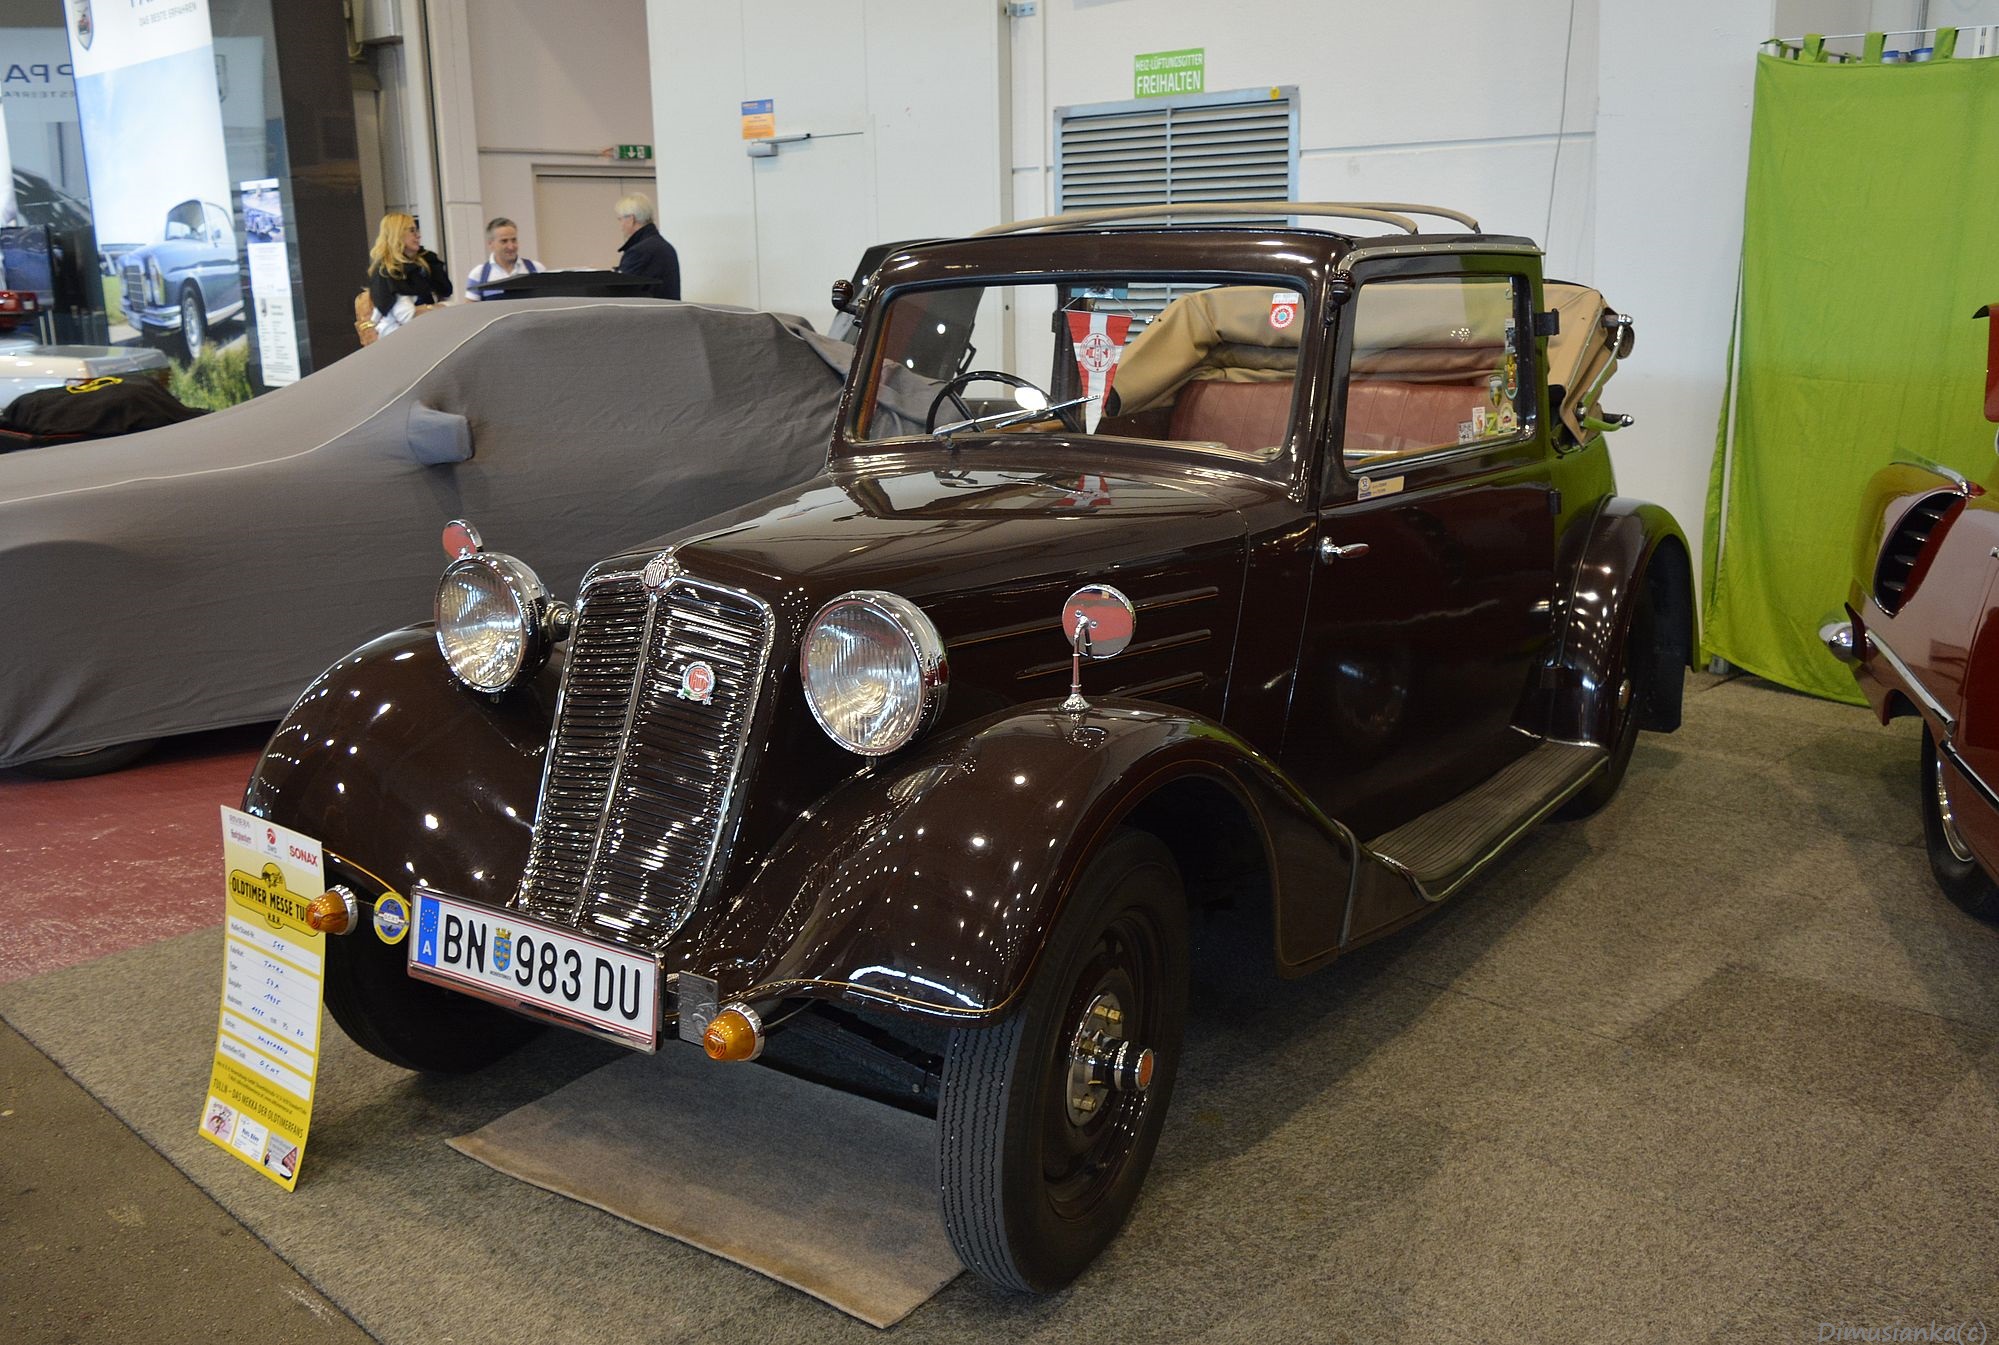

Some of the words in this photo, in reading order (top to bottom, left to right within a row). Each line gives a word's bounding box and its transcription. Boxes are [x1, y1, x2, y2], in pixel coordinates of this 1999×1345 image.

[1136, 70, 1201, 95] FREIHALTEN
[289, 845, 318, 867] SONAX
[231, 877, 267, 905] OLDTIMER
[269, 892, 293, 917] MESSE
[295, 903, 305, 922] TU
[422, 940, 432, 956] A
[443, 914, 487, 974] BN
[515, 935, 582, 1002] 983
[593, 957, 641, 1021] DU
